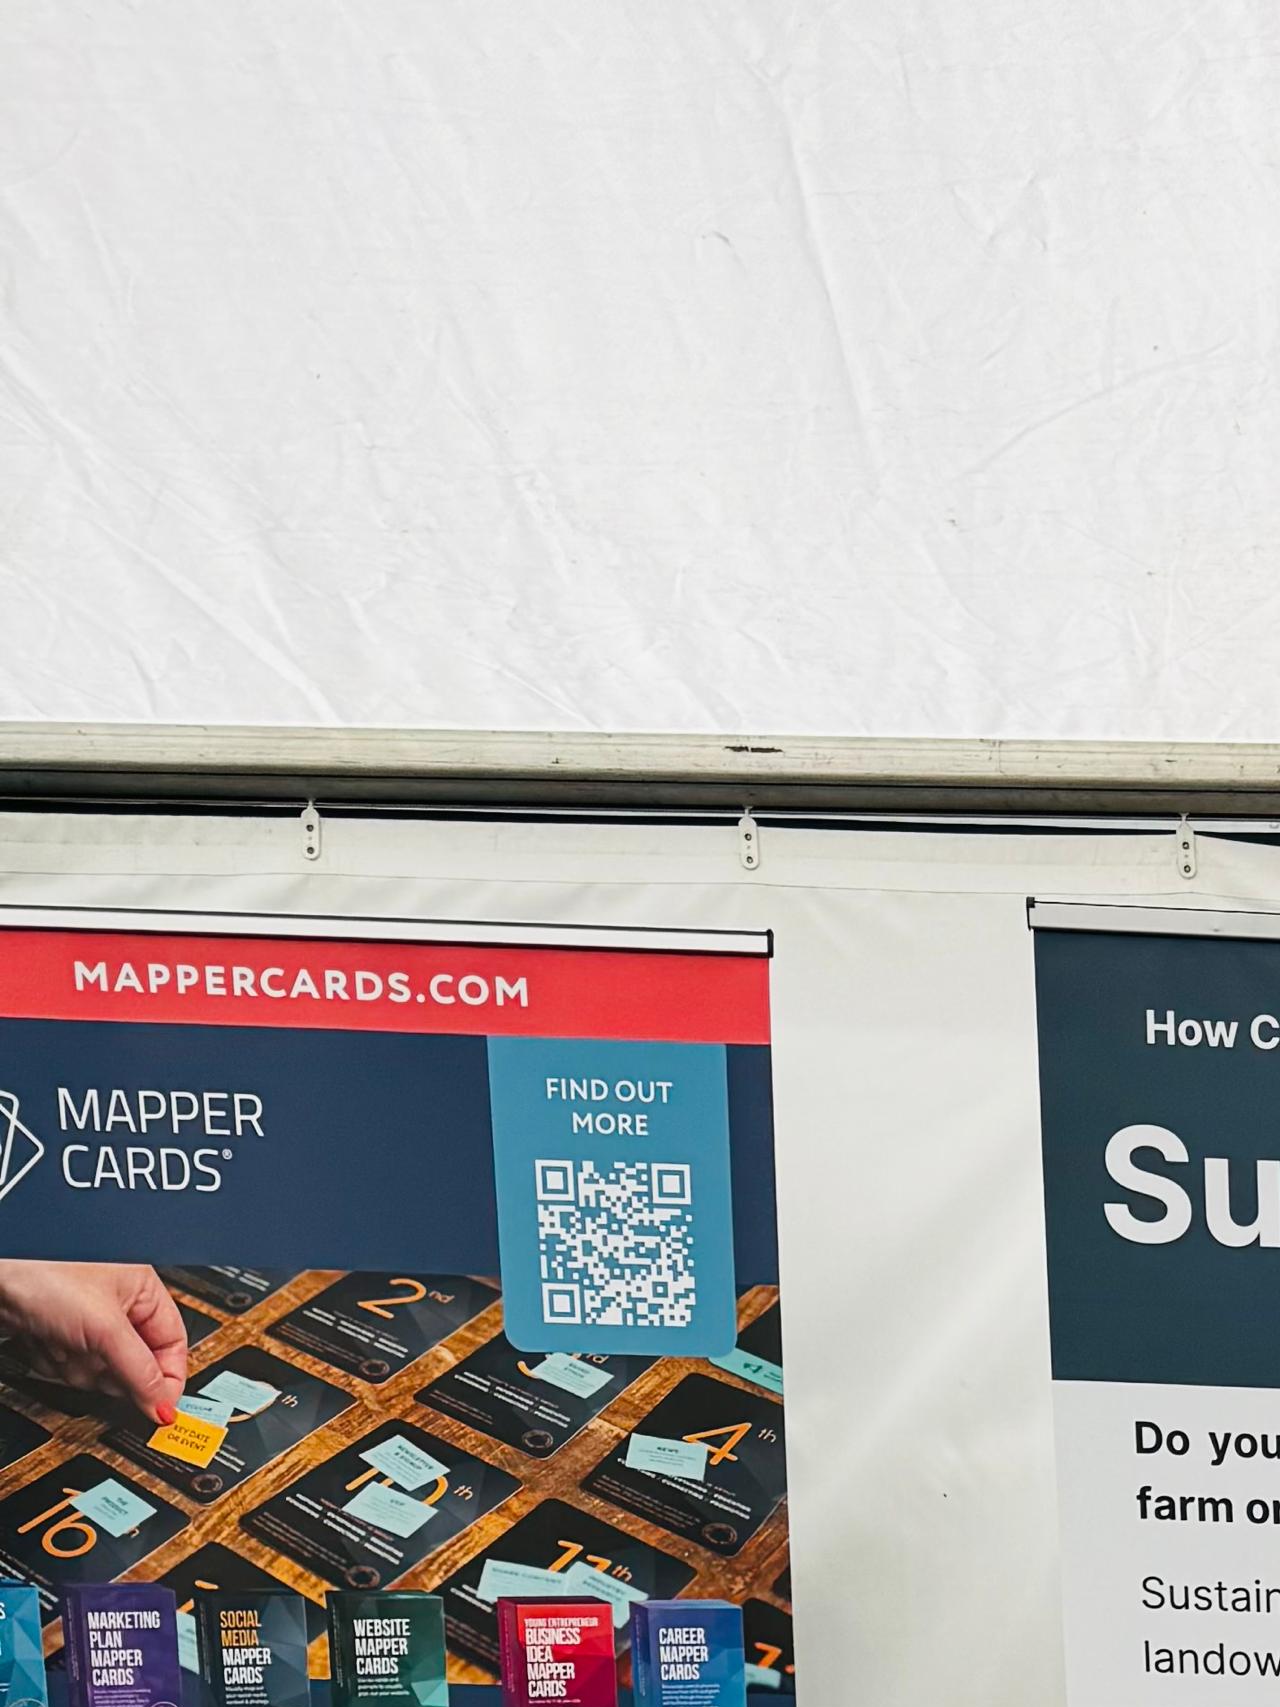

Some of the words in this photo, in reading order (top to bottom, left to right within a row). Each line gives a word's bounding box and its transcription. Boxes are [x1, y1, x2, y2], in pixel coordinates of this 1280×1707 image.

[73, 960, 529, 1007] MAPPERCARDS.COM
[1144, 1010, 1238, 1048] How
[547, 1077, 609, 1101] FIND
[615, 1078, 673, 1104] OUT
[57, 1087, 264, 1137] MAPPER
[572, 1112, 649, 1136] MORE
[87, 1611, 161, 1629] MARKETING
[354, 1618, 410, 1637] WEBSITE
[90, 1631, 123, 1648] PLAN
[659, 1628, 705, 1645] CAREER
[355, 1637, 407, 1657] MAPPER
[661, 1645, 709, 1663] MAPPER
[91, 1649, 142, 1668] MAPPER
[356, 1657, 398, 1675] CARDS
[93, 1668, 135, 1686] CARDS
[661, 1663, 699, 1681] CARDS
